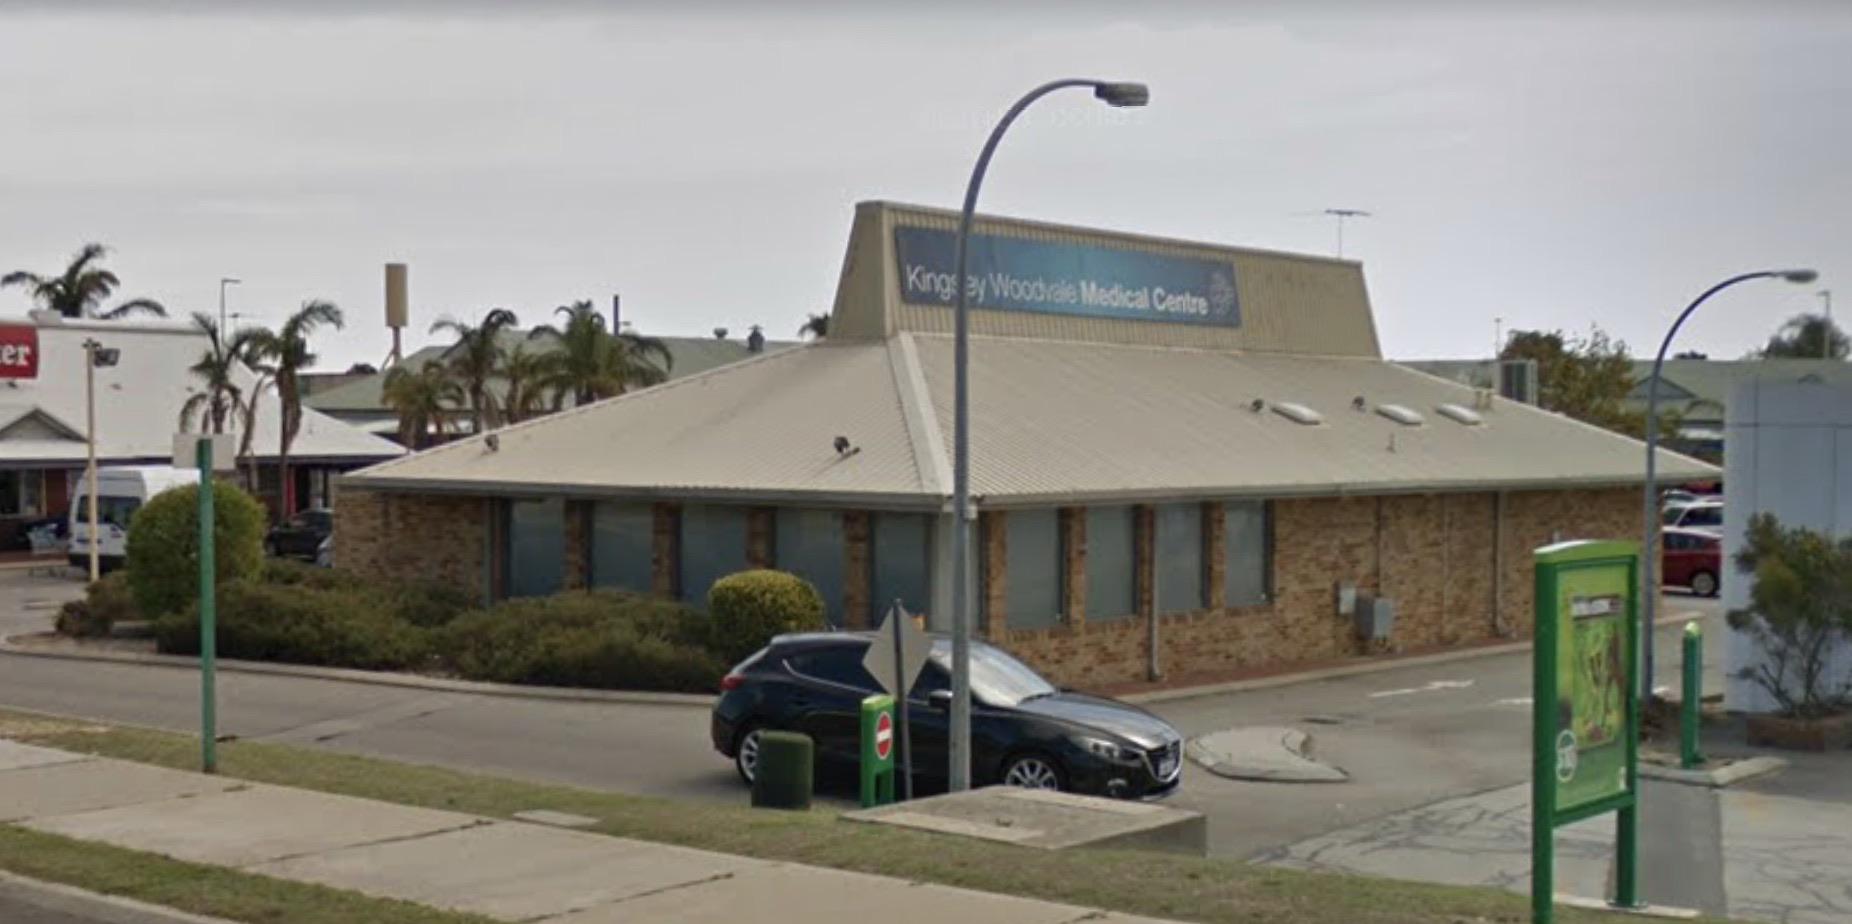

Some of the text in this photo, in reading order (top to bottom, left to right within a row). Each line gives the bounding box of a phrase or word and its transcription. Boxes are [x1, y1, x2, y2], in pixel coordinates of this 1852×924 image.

[906, 263, 1209, 315] Kingsey Woodvale Medical Centre
[0, 344, 31, 367] er
